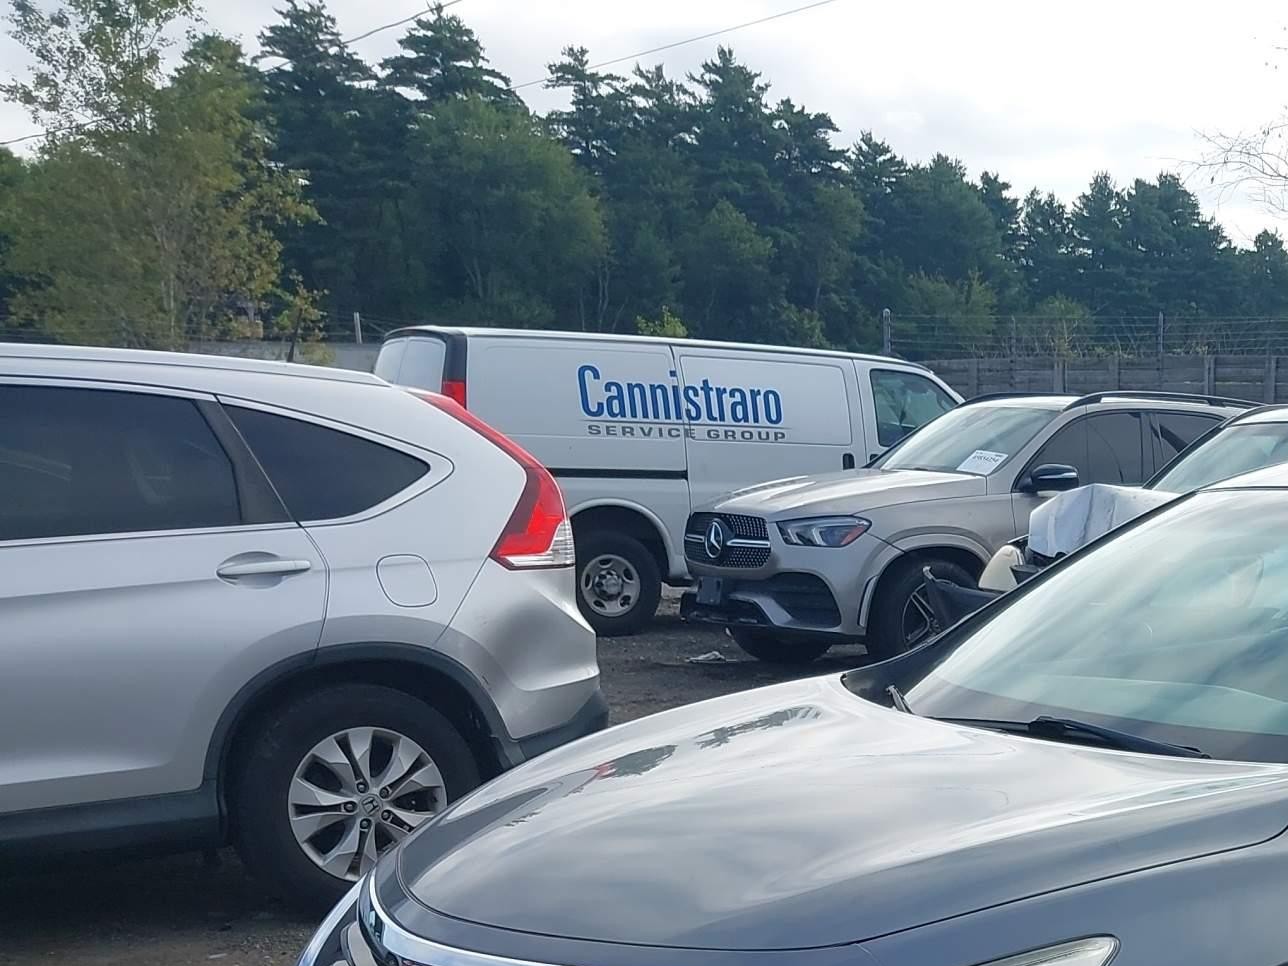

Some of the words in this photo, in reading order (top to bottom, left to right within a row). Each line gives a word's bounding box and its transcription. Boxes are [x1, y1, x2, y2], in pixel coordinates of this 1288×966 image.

[577, 364, 784, 425] Cannistraro
[587, 424, 696, 439] SERVICE
[706, 428, 786, 441] GROUP
